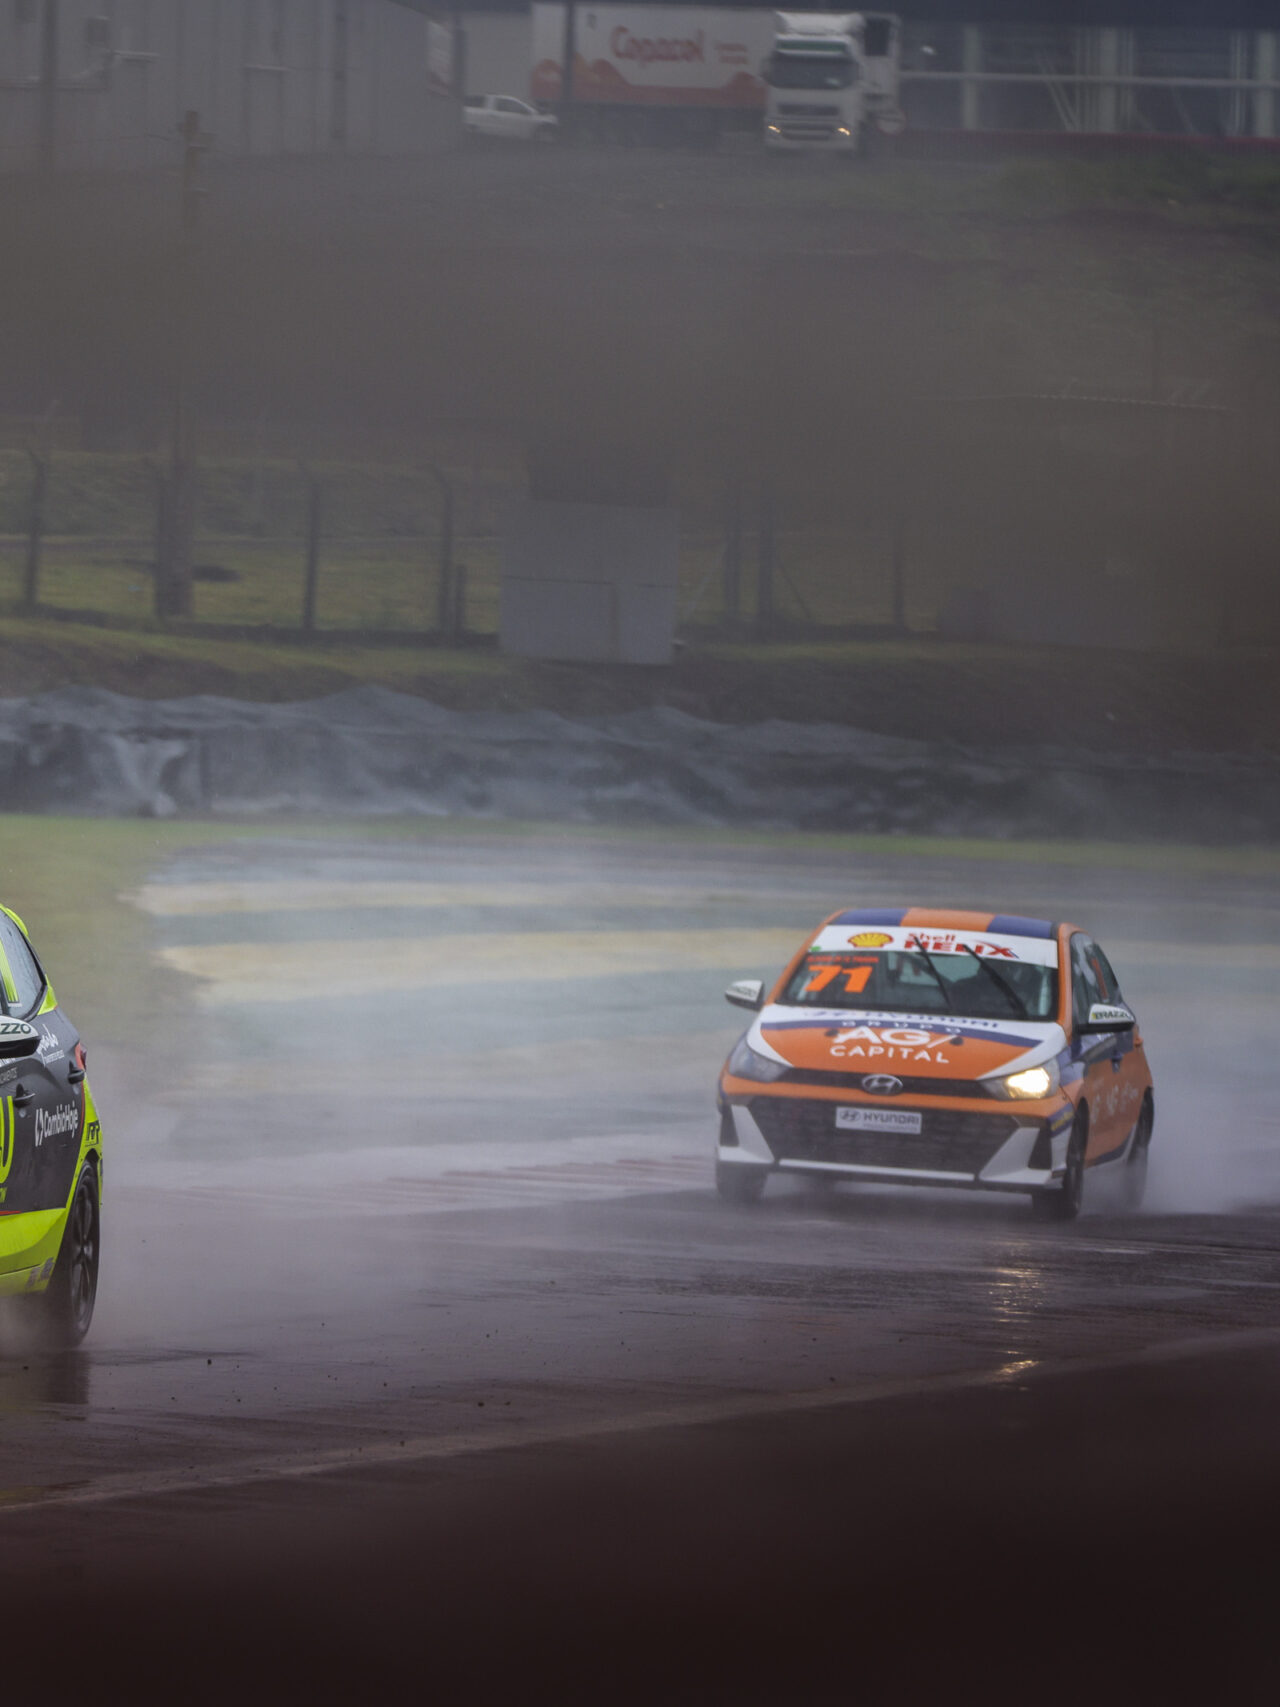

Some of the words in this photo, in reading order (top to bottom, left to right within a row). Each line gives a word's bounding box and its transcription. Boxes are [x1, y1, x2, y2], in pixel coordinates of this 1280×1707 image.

[907, 932, 956, 943] Shell
[804, 964, 873, 993] 71
[829, 1044, 950, 1064] CAPITAL
[863, 1111, 920, 1125] HYUNDAI
